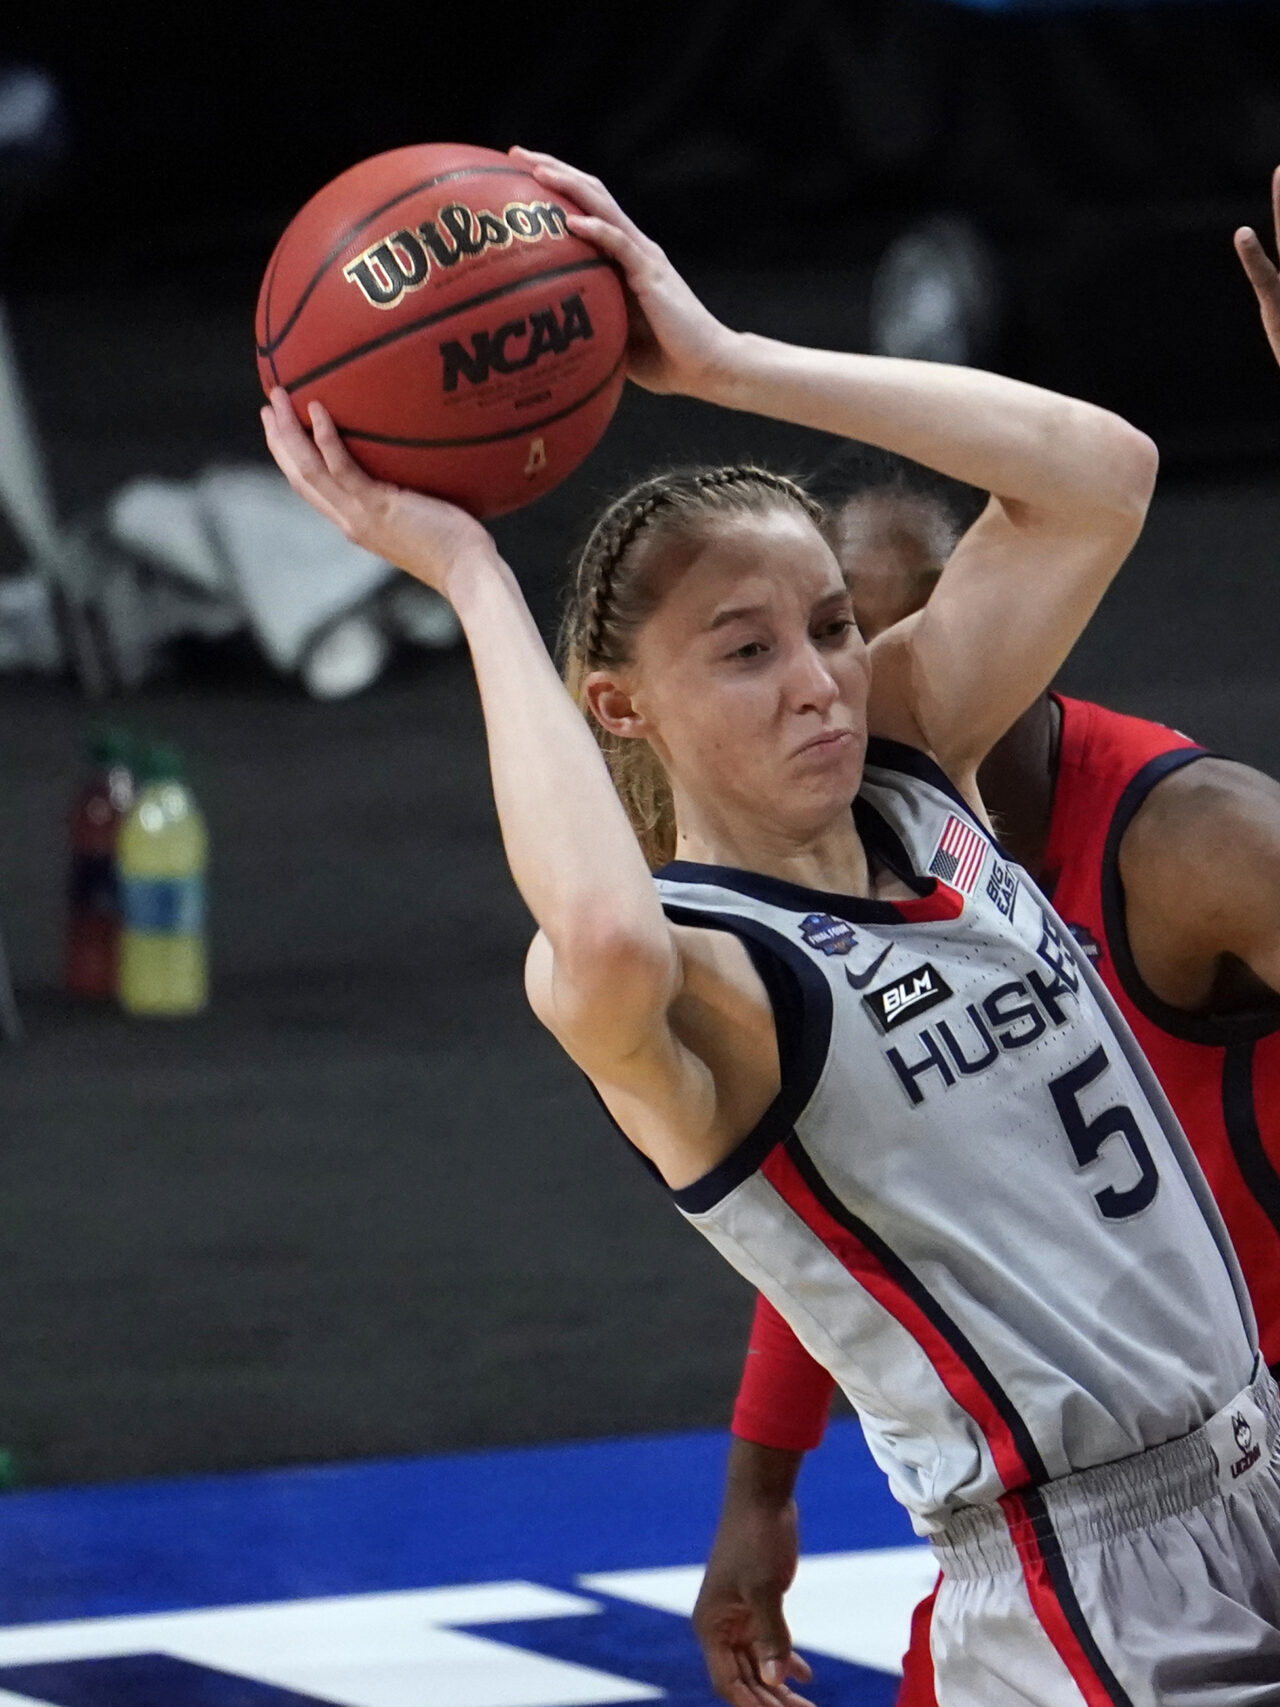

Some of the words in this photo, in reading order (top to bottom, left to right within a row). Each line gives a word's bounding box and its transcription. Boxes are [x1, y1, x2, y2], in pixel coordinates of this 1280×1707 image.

[343, 201, 570, 310] Wilson
[439, 291, 594, 392] NCAA
[986, 859, 1004, 904] BIG
[882, 969, 933, 1014] BLM
[1047, 1044, 1160, 1219] 5
